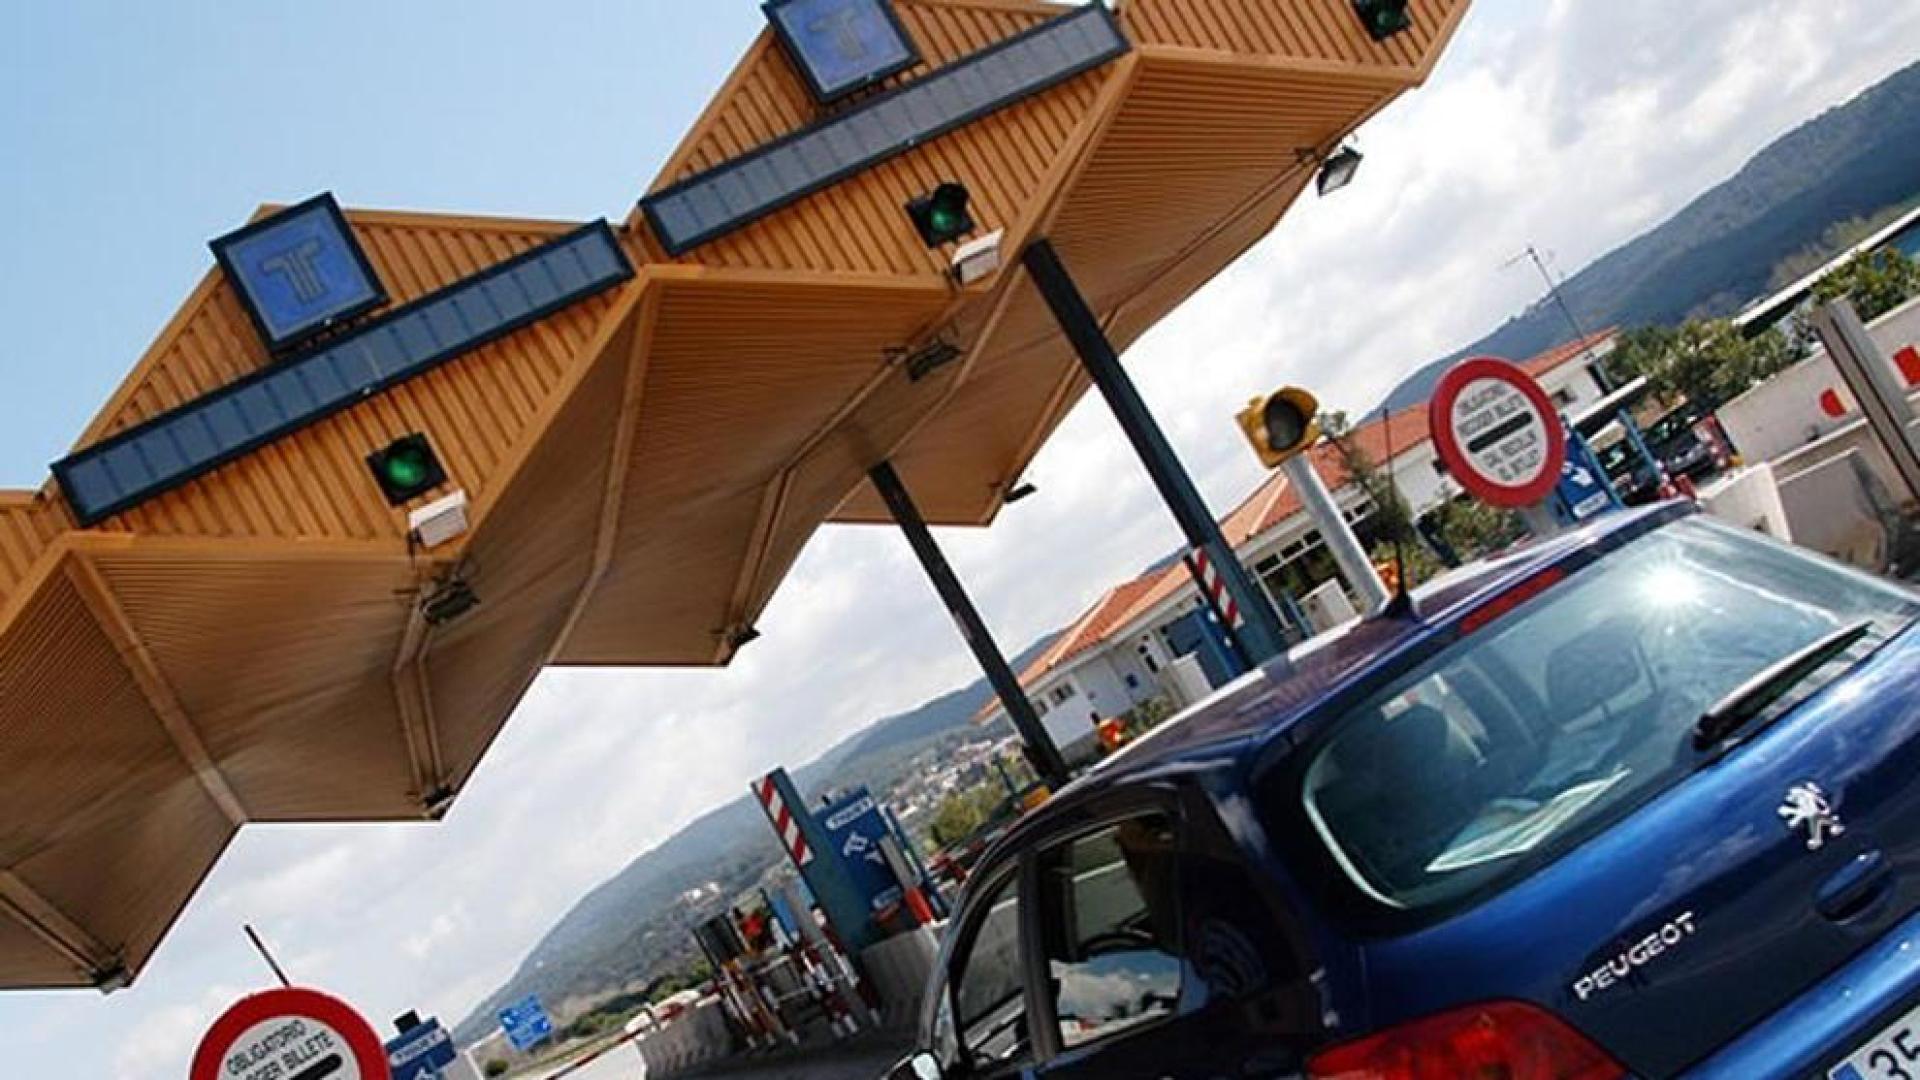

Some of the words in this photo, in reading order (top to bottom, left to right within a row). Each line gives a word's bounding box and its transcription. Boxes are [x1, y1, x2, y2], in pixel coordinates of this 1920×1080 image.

[1573, 911, 1694, 1000] PEUGEOT
[227, 1019, 307, 1076] OBLIGATORIO
[281, 1031, 335, 1071] BILLETE
